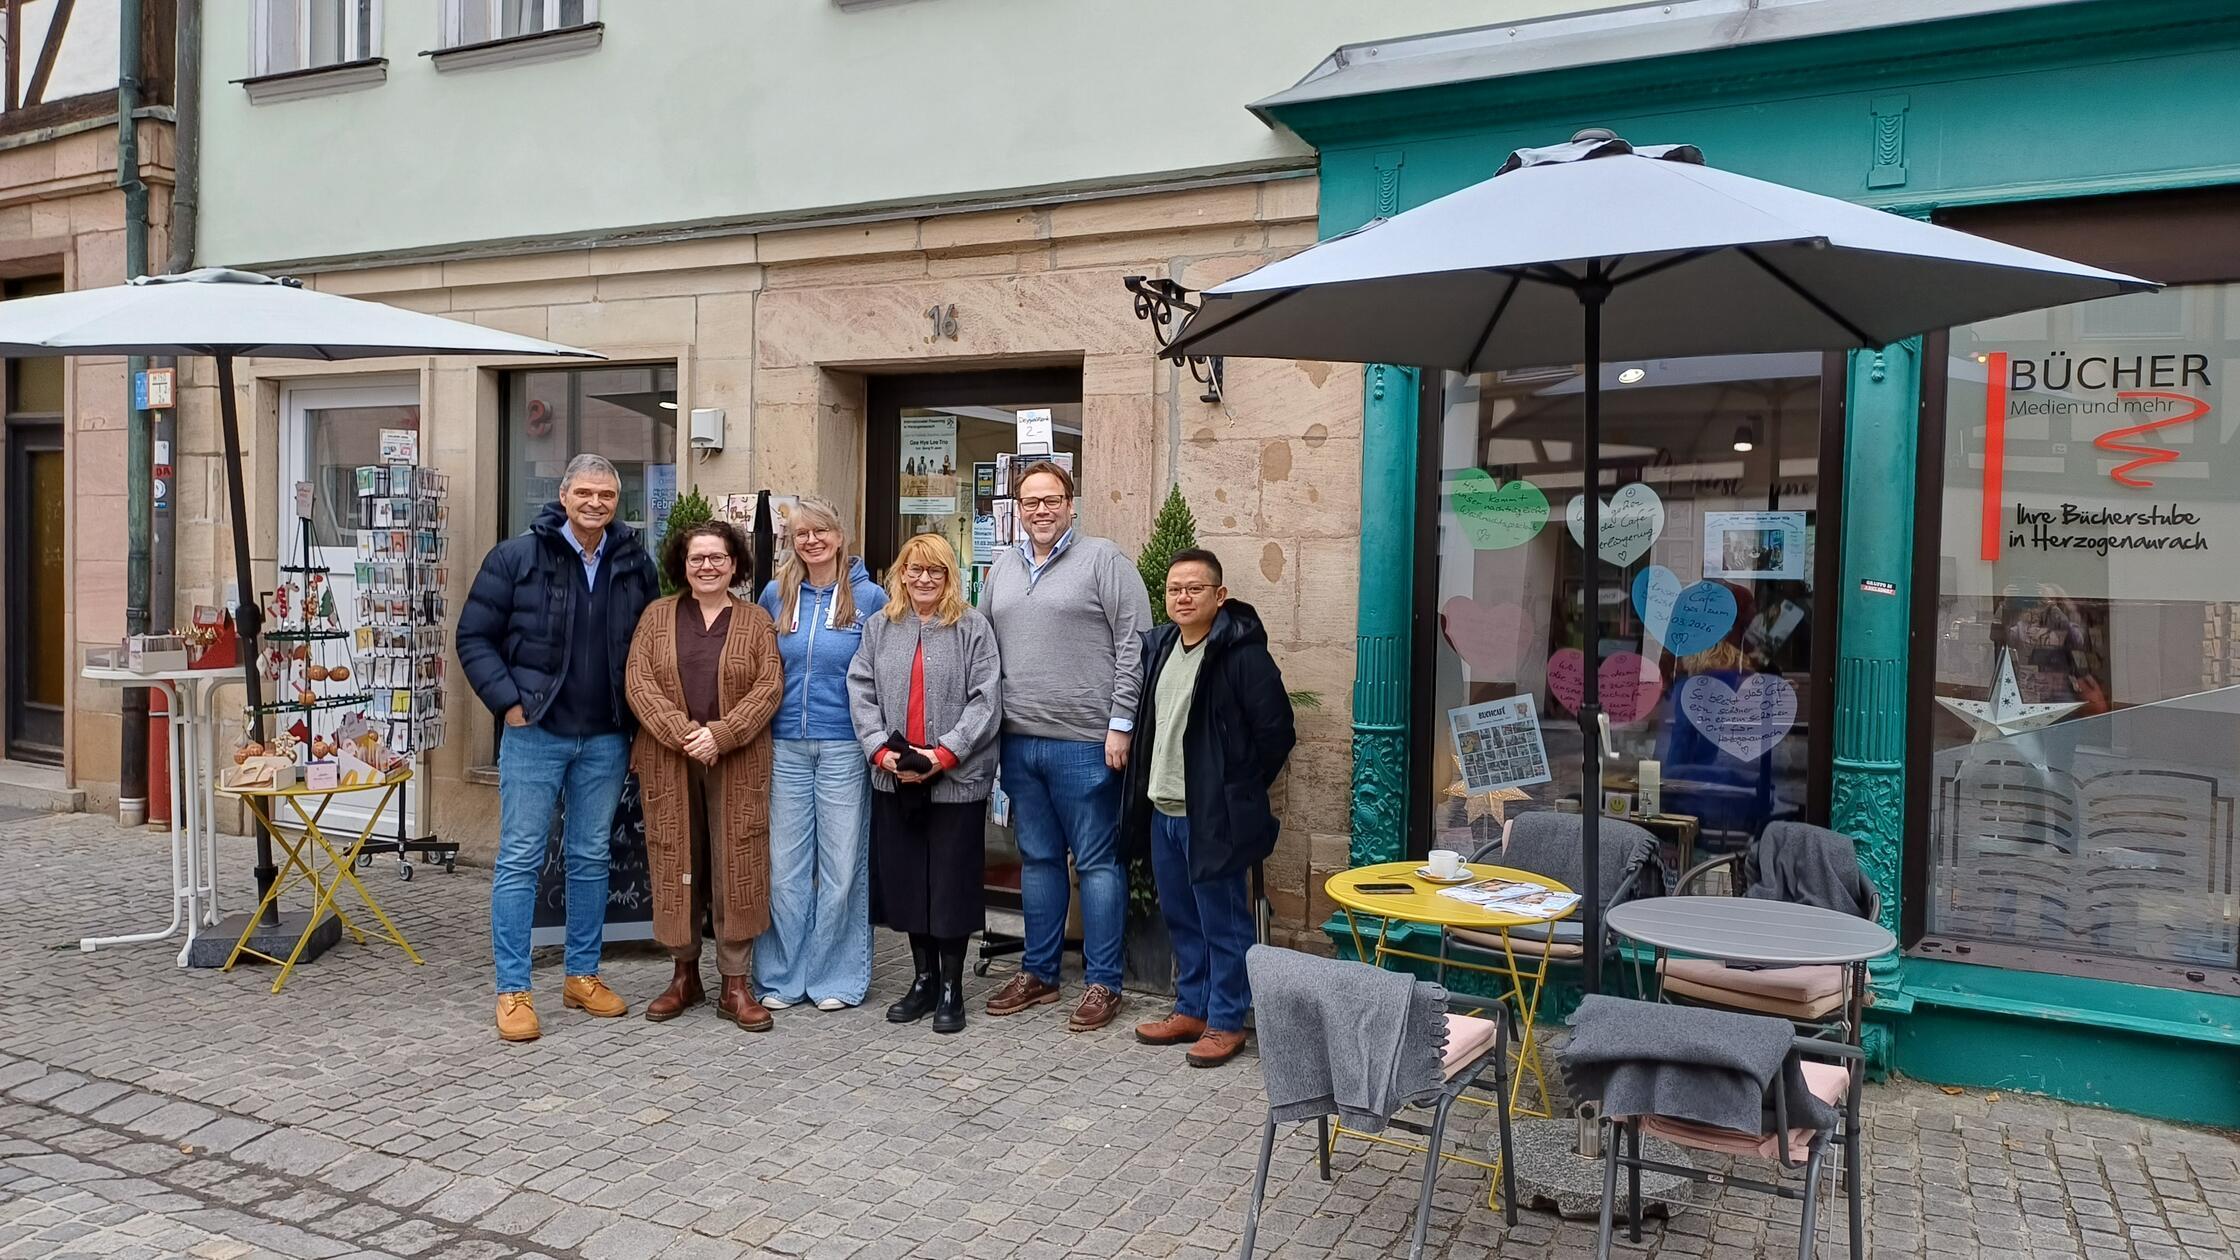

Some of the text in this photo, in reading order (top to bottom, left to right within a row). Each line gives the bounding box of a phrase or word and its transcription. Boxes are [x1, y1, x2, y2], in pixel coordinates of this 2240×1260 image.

[928, 304, 958, 338] 16
[2011, 351, 2212, 391] BÜCHER
[2010, 397, 2176, 416] Medien und mehr
[2016, 503, 2201, 525] Ihre Bücherstube
[1600, 528, 1656, 549] erlängerung
[2009, 524, 2208, 557] in Herzogenaurach
[1689, 688, 1703, 700] So
[1744, 689, 1763, 700] das
